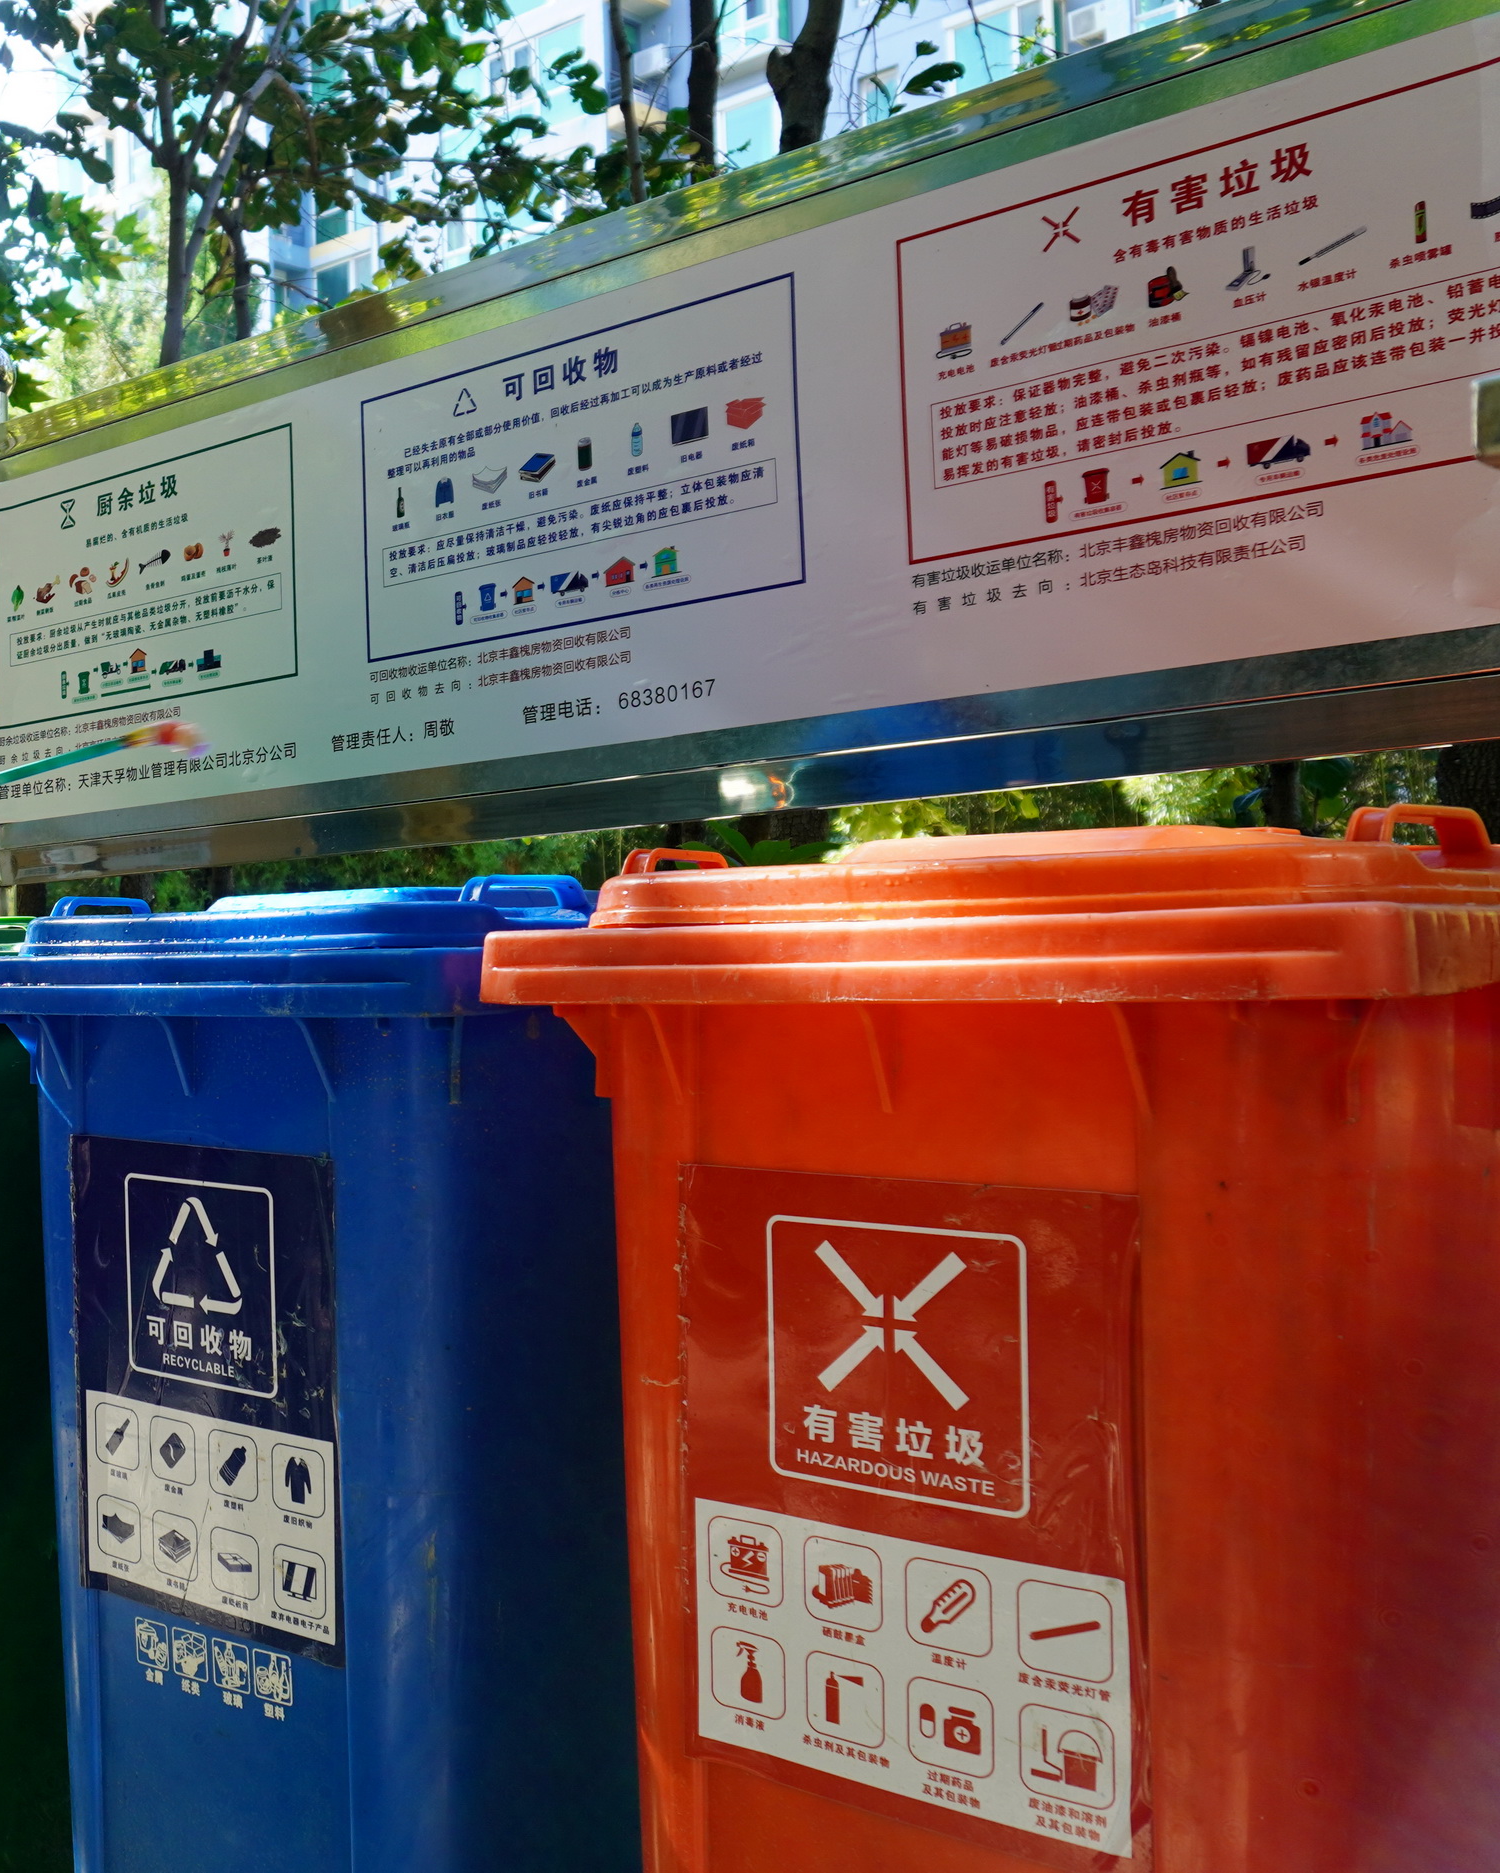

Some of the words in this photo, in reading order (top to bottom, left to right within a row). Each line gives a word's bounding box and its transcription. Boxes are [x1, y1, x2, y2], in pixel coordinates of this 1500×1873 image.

[1122, 143, 1312, 227] 有害垃圾
[1113, 195, 1318, 263] 含有毒有害物质的生活垃圾
[1297, 268, 1357, 292] 水银温度计
[1232, 291, 1267, 309] 血压计
[503, 346, 619, 403] 可回收物
[938, 363, 975, 380] 充电电池
[387, 447, 476, 479] 整理可以再利用的物品
[943, 421, 1182, 481] 易挥发的有害垃圾，请密封后投放。
[96, 474, 178, 517] 厨余垃圾
[912, 500, 1324, 588] 有害垃圾收运单位名称：北京丰鑫槐房物资回收有限公司
[369, 626, 631, 683] 可回收物收运单位名称：北京丰鑫槐房物资回收有限公司
[618, 678, 717, 711] 68380167
[331, 718, 455, 754] 管理责任人：周敬
[146, 1315, 252, 1361] 可回收物
[163, 1353, 235, 1378] RECYCLABLE
[803, 1404, 985, 1467] 有害垃圾
[797, 1448, 916, 1484] HAZARDOUS
[921, 1471, 995, 1497] WASTE
[270, 1610, 330, 1635] 废弃电器电子产品
[728, 1602, 769, 1621] 充电电池
[931, 1652, 967, 1671] 温度计
[181, 1679, 201, 1696] 纸类
[222, 1691, 243, 1709] 玻璃
[1017, 1671, 1111, 1702] 废含汞荧光灯管
[263, 1702, 286, 1721] 塑料
[734, 1713, 765, 1732] 消毒液
[802, 1734, 890, 1769] 杀虫剂及其包装物
[922, 1783, 981, 1809] 及其包装物
[927, 1770, 974, 1792] 过期药品
[1028, 1797, 1107, 1828] 废油漆和溶剂
[1035, 1815, 1100, 1842] 及其包装物
